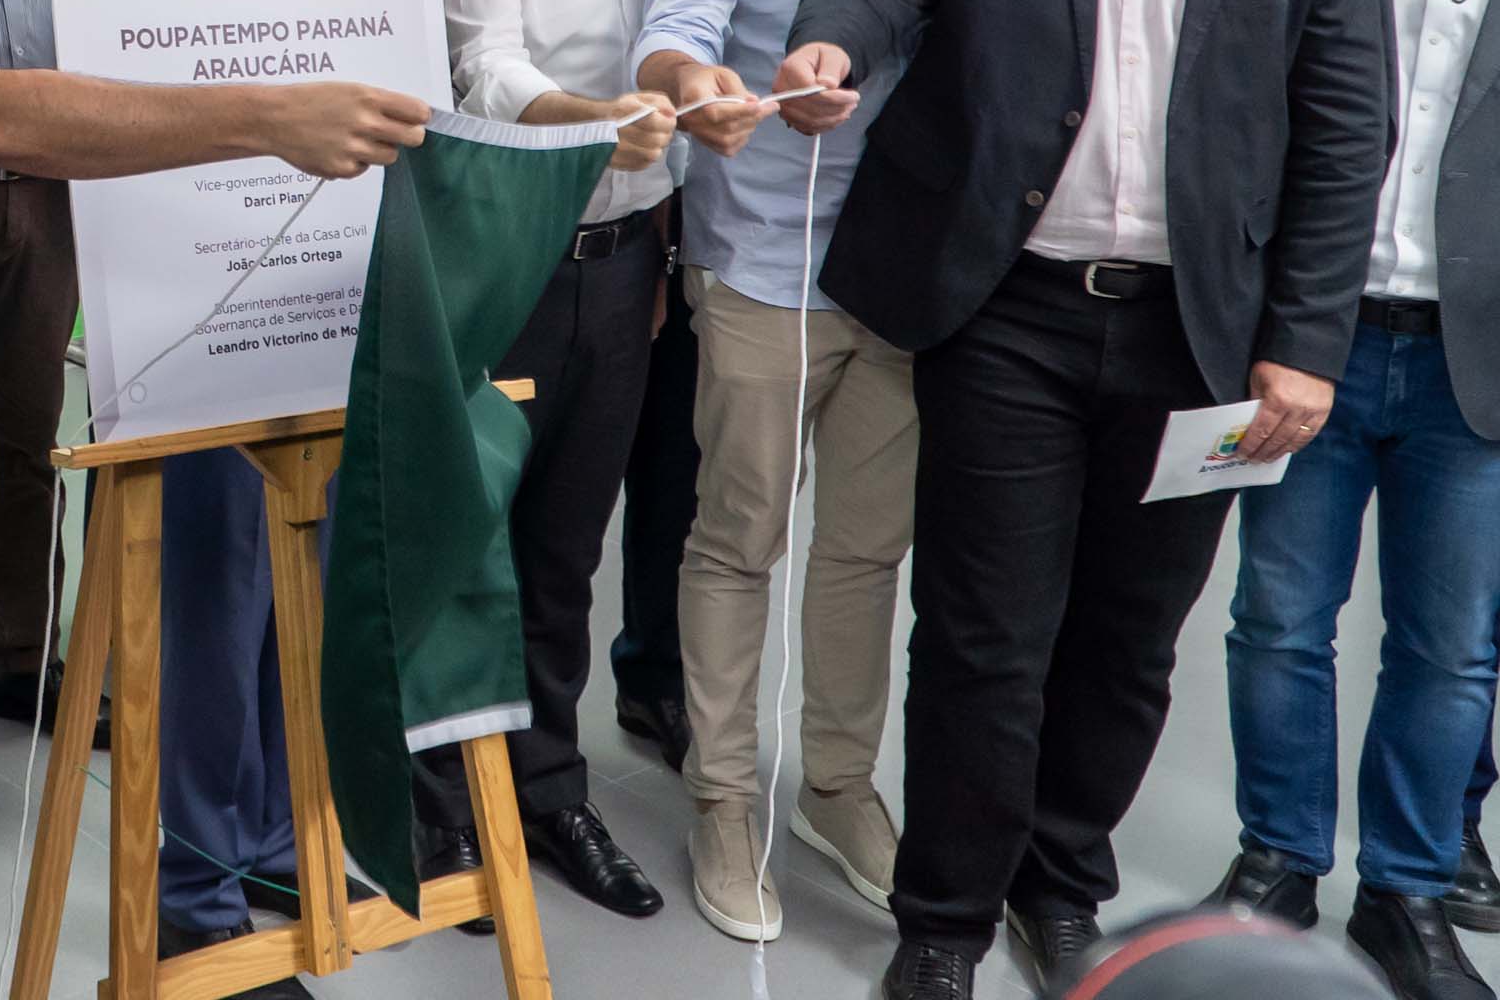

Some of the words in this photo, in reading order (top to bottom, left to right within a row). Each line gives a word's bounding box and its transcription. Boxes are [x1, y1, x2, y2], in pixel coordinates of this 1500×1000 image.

[120, 21, 289, 50] POUPATEMPO
[296, 11, 393, 41] PARANÁ
[193, 49, 335, 80] ARAUCÁRIA
[194, 173, 293, 192] Vice-governador
[244, 193, 276, 208] Darci
[296, 231, 310, 243] da
[313, 229, 341, 242] Casa
[343, 225, 368, 238] Civil
[260, 254, 297, 268] Carlos
[301, 250, 342, 264] Ortega
[348, 285, 362, 298] de
[269, 313, 284, 326] de
[288, 305, 336, 323] Serviços
[339, 308, 347, 317] e
[208, 340, 260, 356] Leandro
[262, 331, 319, 348] Victorino
[322, 327, 337, 340] de
